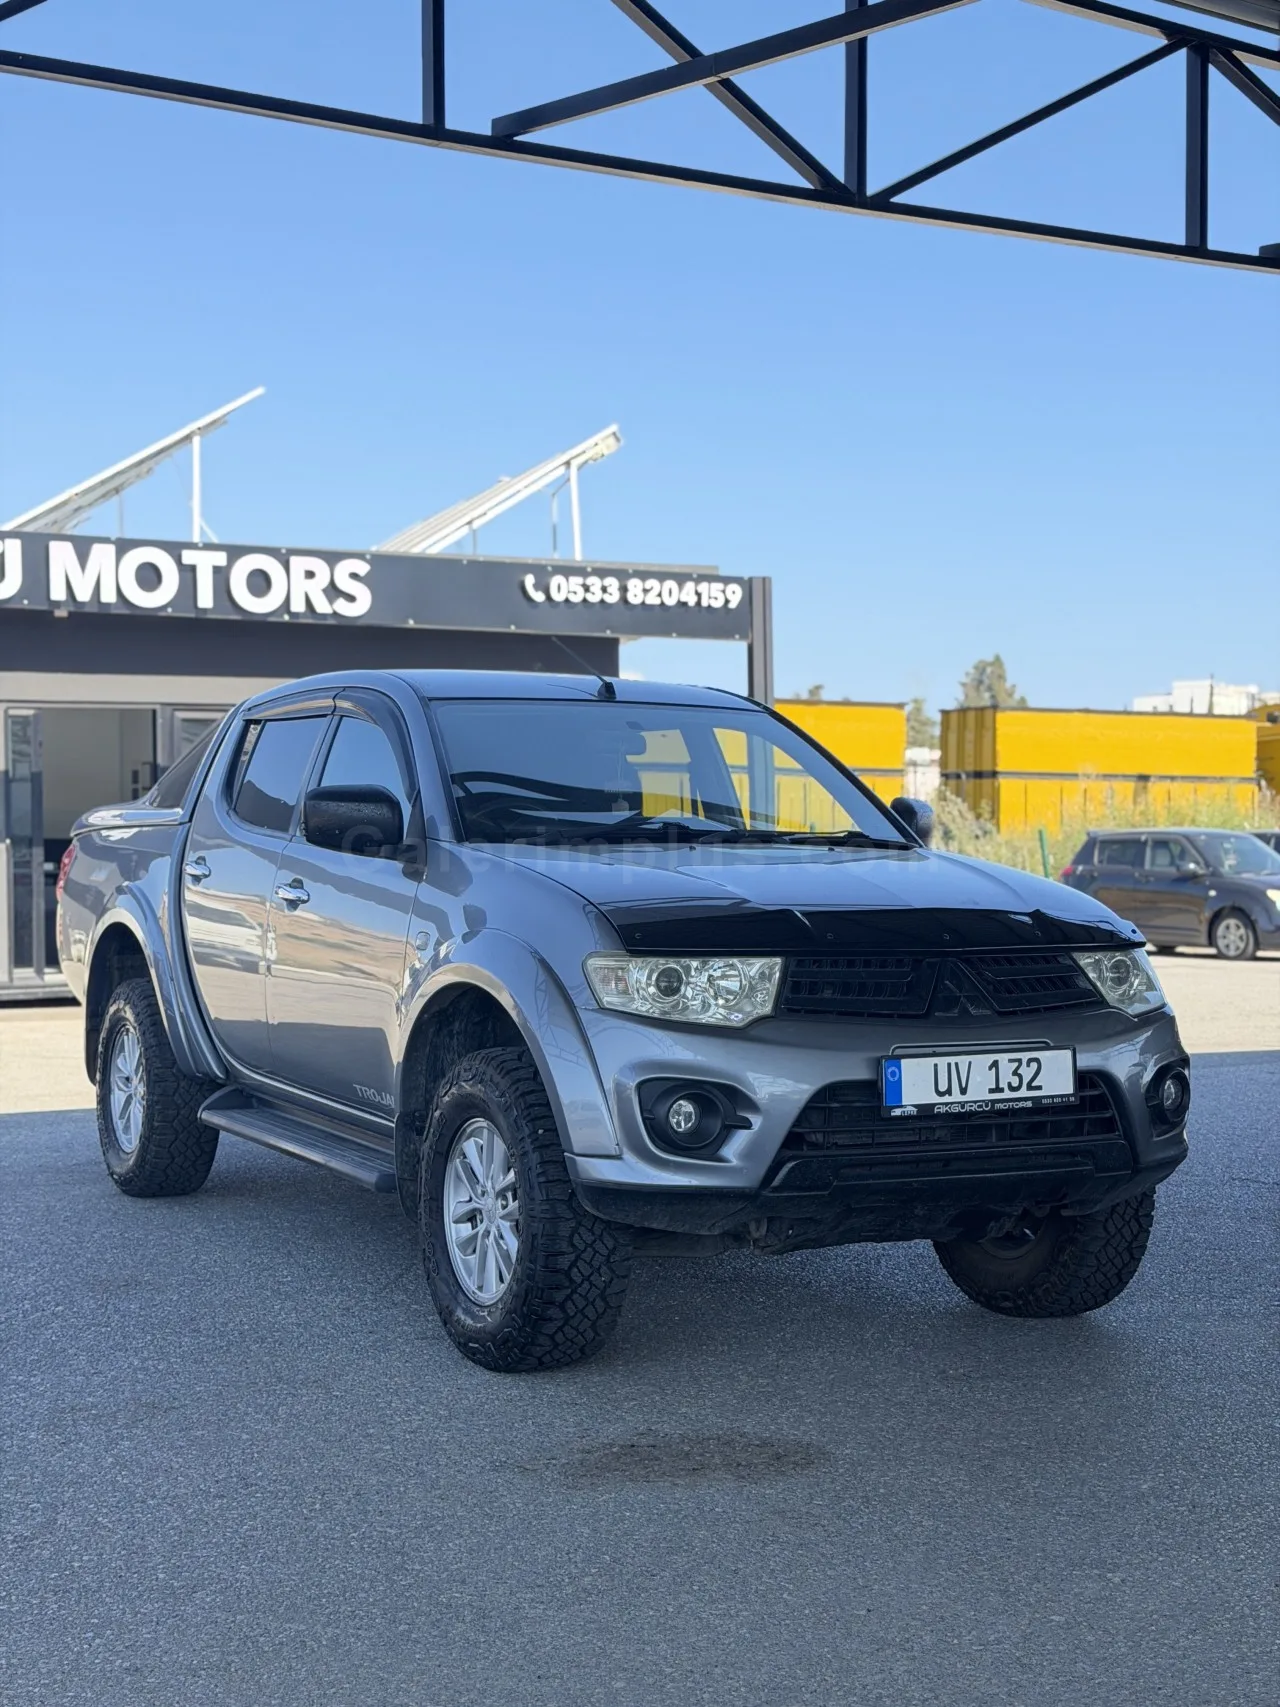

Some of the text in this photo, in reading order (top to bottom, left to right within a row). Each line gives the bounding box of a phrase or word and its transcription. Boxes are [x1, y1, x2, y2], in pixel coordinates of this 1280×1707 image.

[48, 540, 373, 617] MOTORS
[549, 574, 743, 609] 0533 8204159
[933, 1057, 1043, 1097] UV 132
[934, 1100, 991, 1114] AKGÜRCÜ
[994, 1100, 1033, 1111] MOTORS
